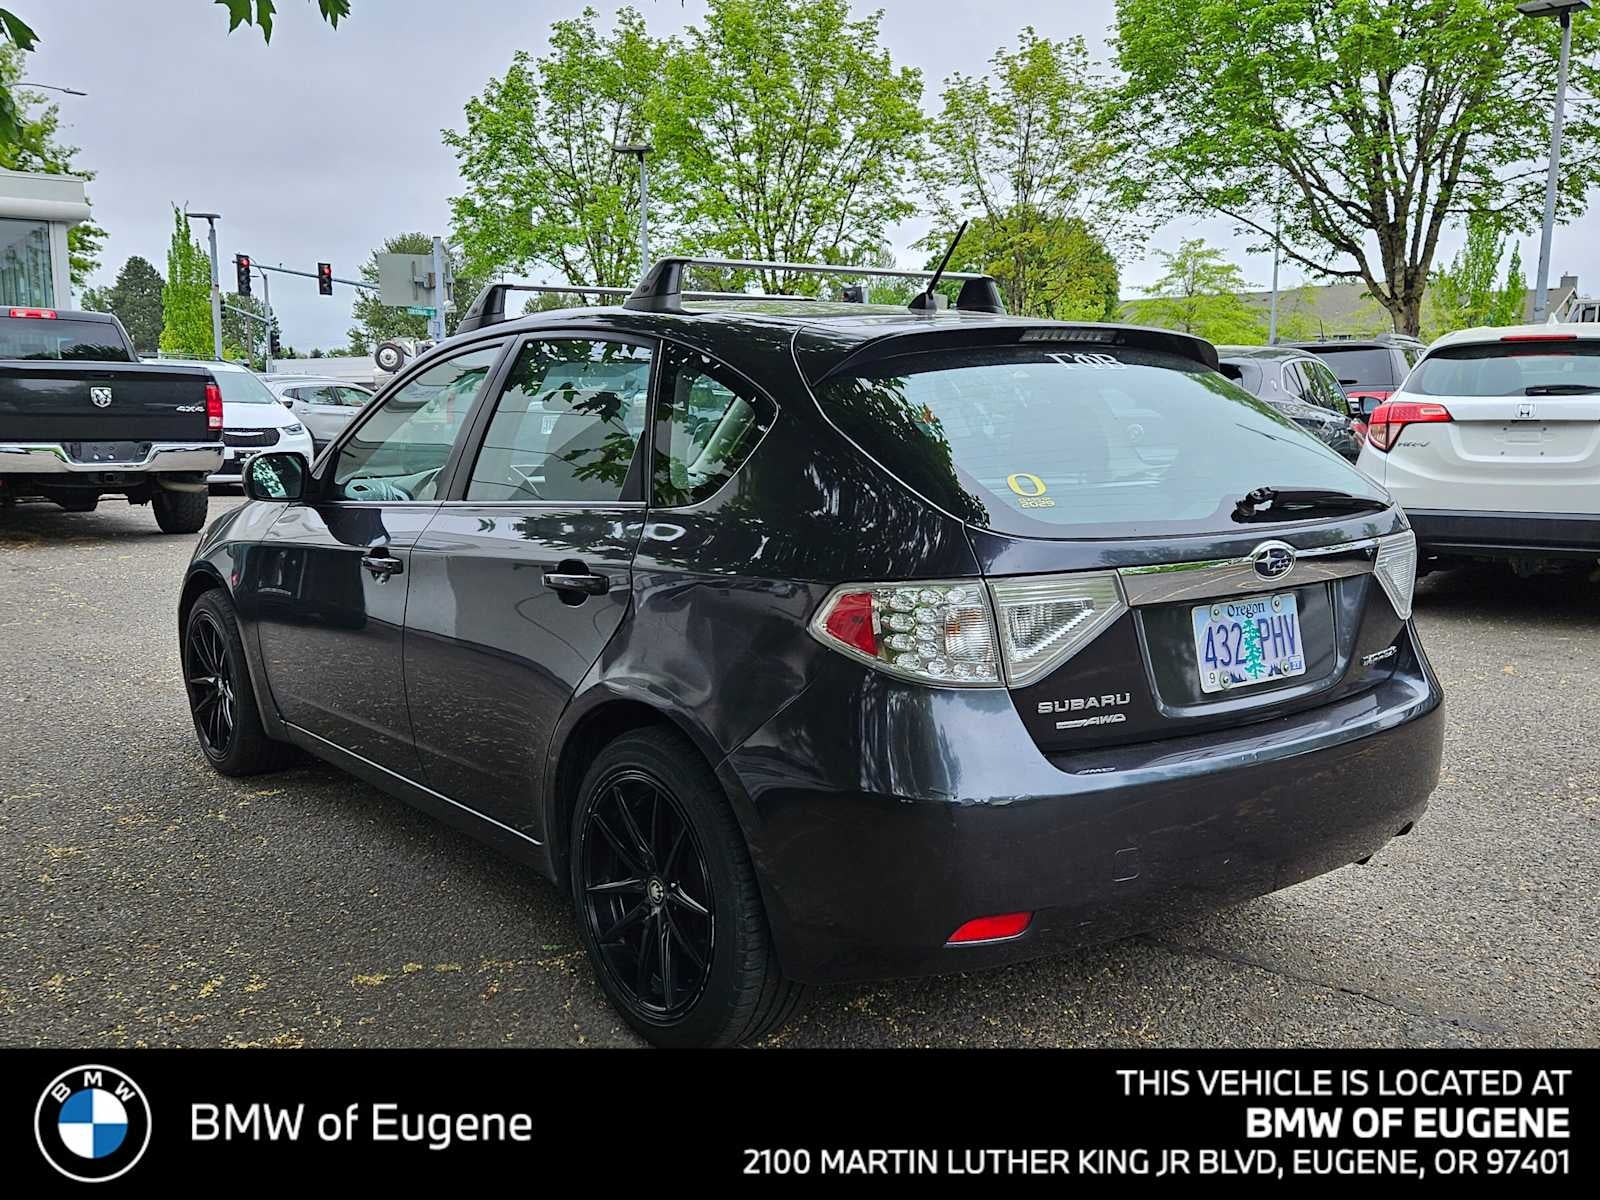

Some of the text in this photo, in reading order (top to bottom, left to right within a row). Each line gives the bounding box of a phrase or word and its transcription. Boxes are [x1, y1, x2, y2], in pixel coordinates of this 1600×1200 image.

[1007, 473, 1047, 497] O
[1227, 602, 1265, 618] Oregon
[1205, 613, 1296, 669] 432 PHV
[1209, 671, 1217, 684] 9
[1037, 692, 1130, 714] SUBARU
[1084, 713, 1127, 727] AWD
